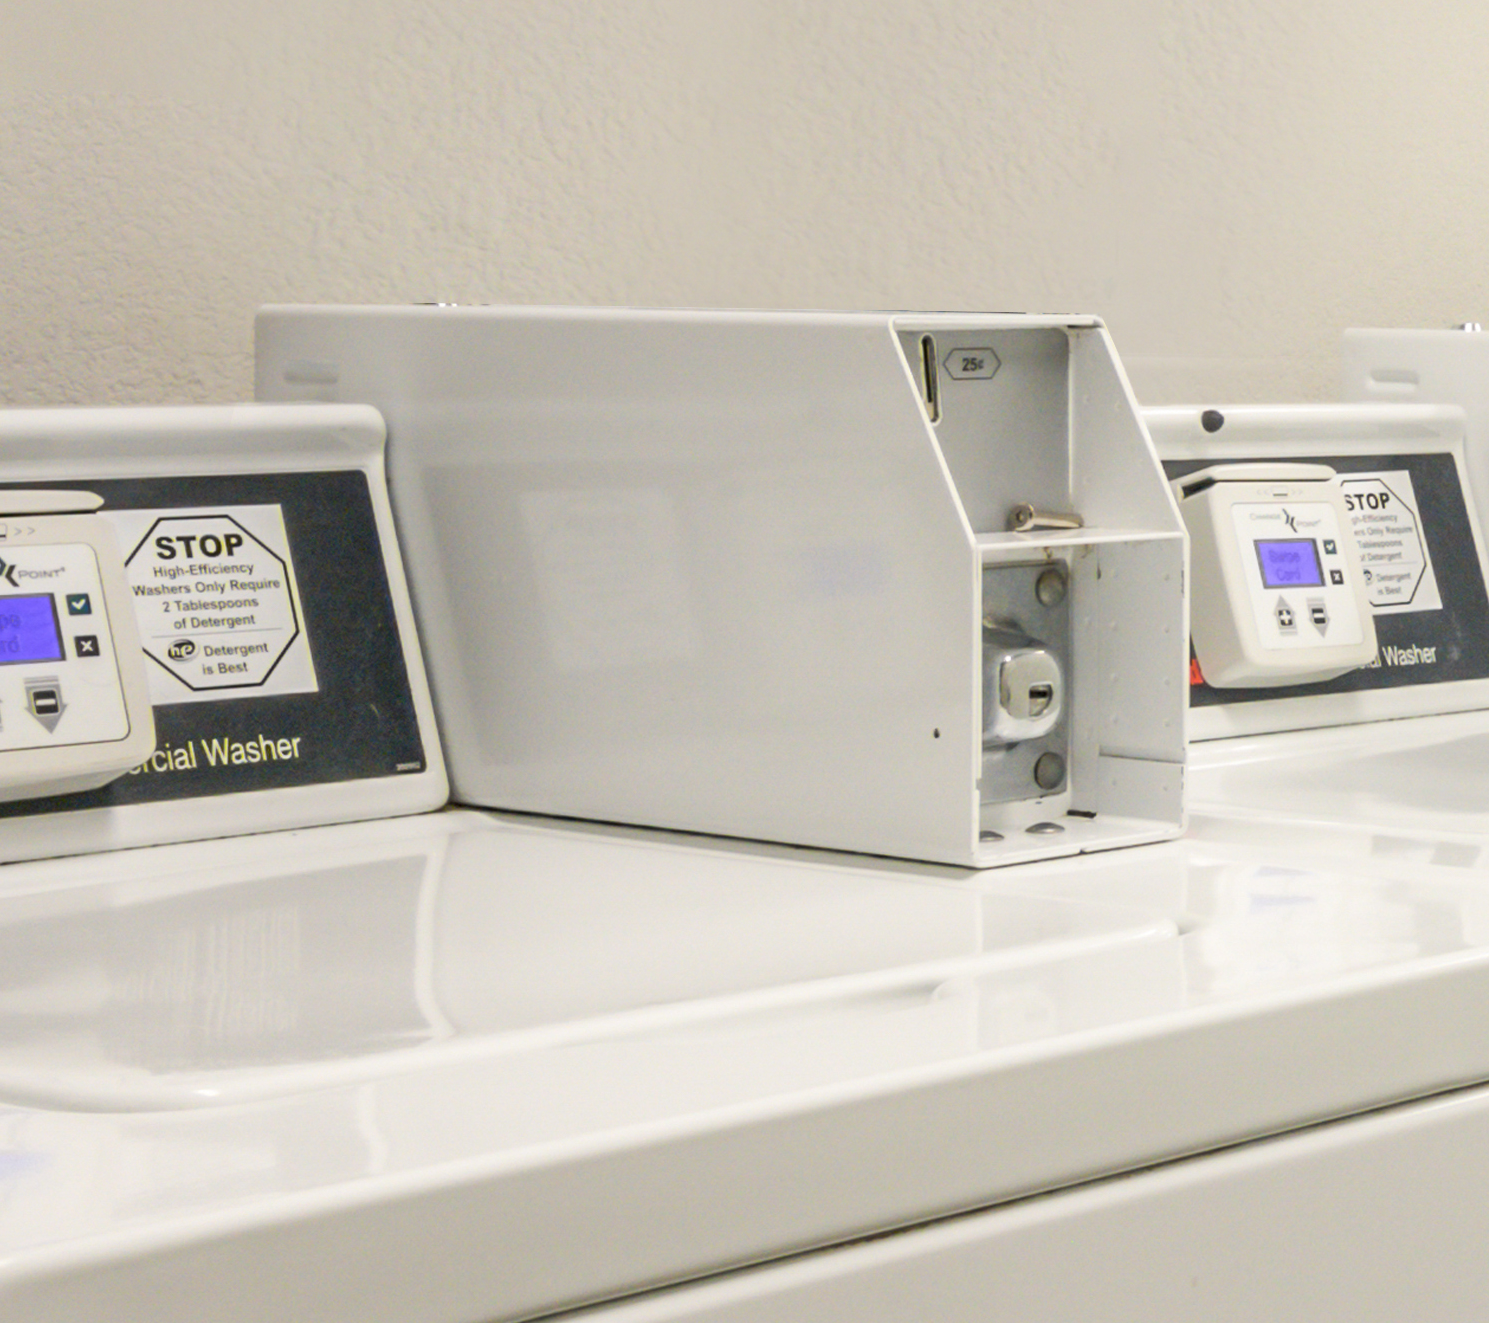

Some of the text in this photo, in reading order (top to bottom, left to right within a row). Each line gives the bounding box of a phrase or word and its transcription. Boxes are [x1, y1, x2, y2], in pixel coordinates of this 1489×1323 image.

[1351, 514, 1398, 526] gh-Efficiency
[155, 533, 243, 560] STOP
[153, 563, 254, 579] High-Efficiency
[132, 578, 281, 597] Washers Only Require
[162, 597, 259, 615] 2 Tablespoons
[173, 614, 256, 629] of Detergent
[203, 642, 269, 657] Detergent
[1382, 644, 1436, 667] Washer
[202, 662, 249, 675] is Best
[201, 733, 301, 766] Washer
